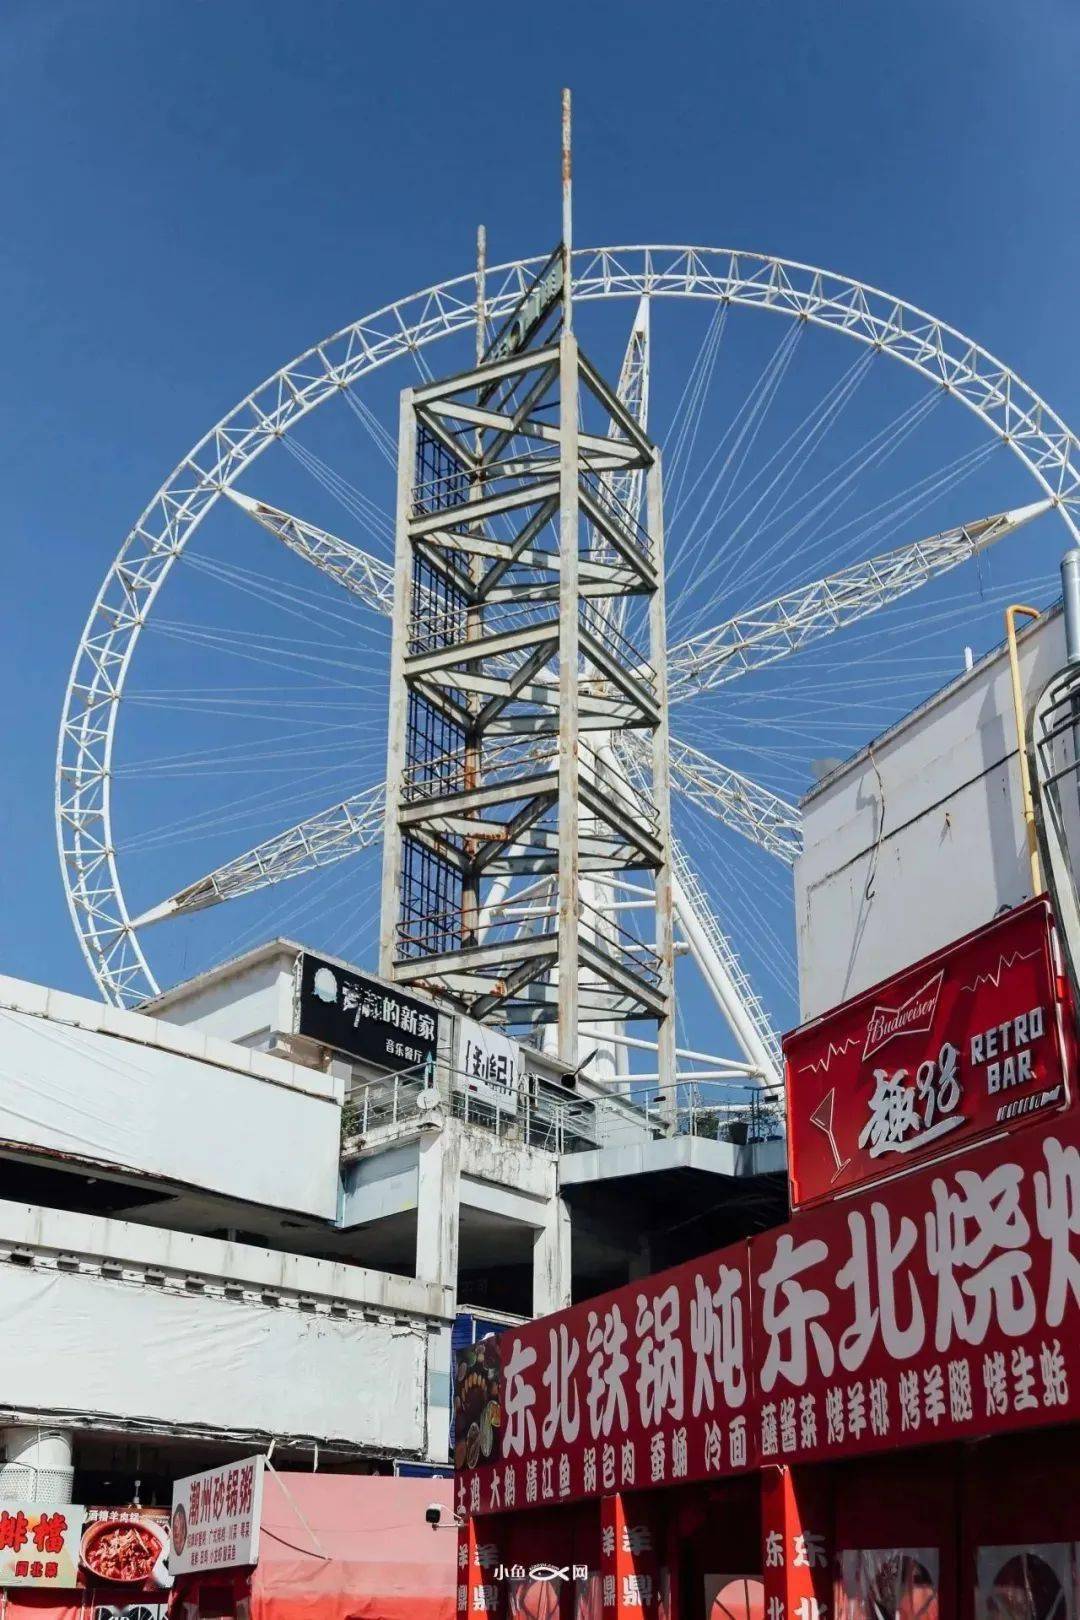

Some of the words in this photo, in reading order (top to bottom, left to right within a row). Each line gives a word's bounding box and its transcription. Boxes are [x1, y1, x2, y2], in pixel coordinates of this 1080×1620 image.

[867, 997, 937, 1043] Budweiser
[970, 1006, 1043, 1066] RETRO
[386, 1038, 422, 1064] 音乐餐厅
[987, 1049, 1033, 1095] BAR
[502, 1264, 747, 1459] 东北铁锅炖
[825, 1377, 890, 1446] 烤羊排
[898, 1358, 973, 1432] 烤羊腿
[982, 1338, 1069, 1417] 烤生蚝
[583, 1439, 636, 1493] 锅包肉
[704, 1415, 747, 1472] 冷面
[188, 1465, 254, 1526] 潮州砂锅粥
